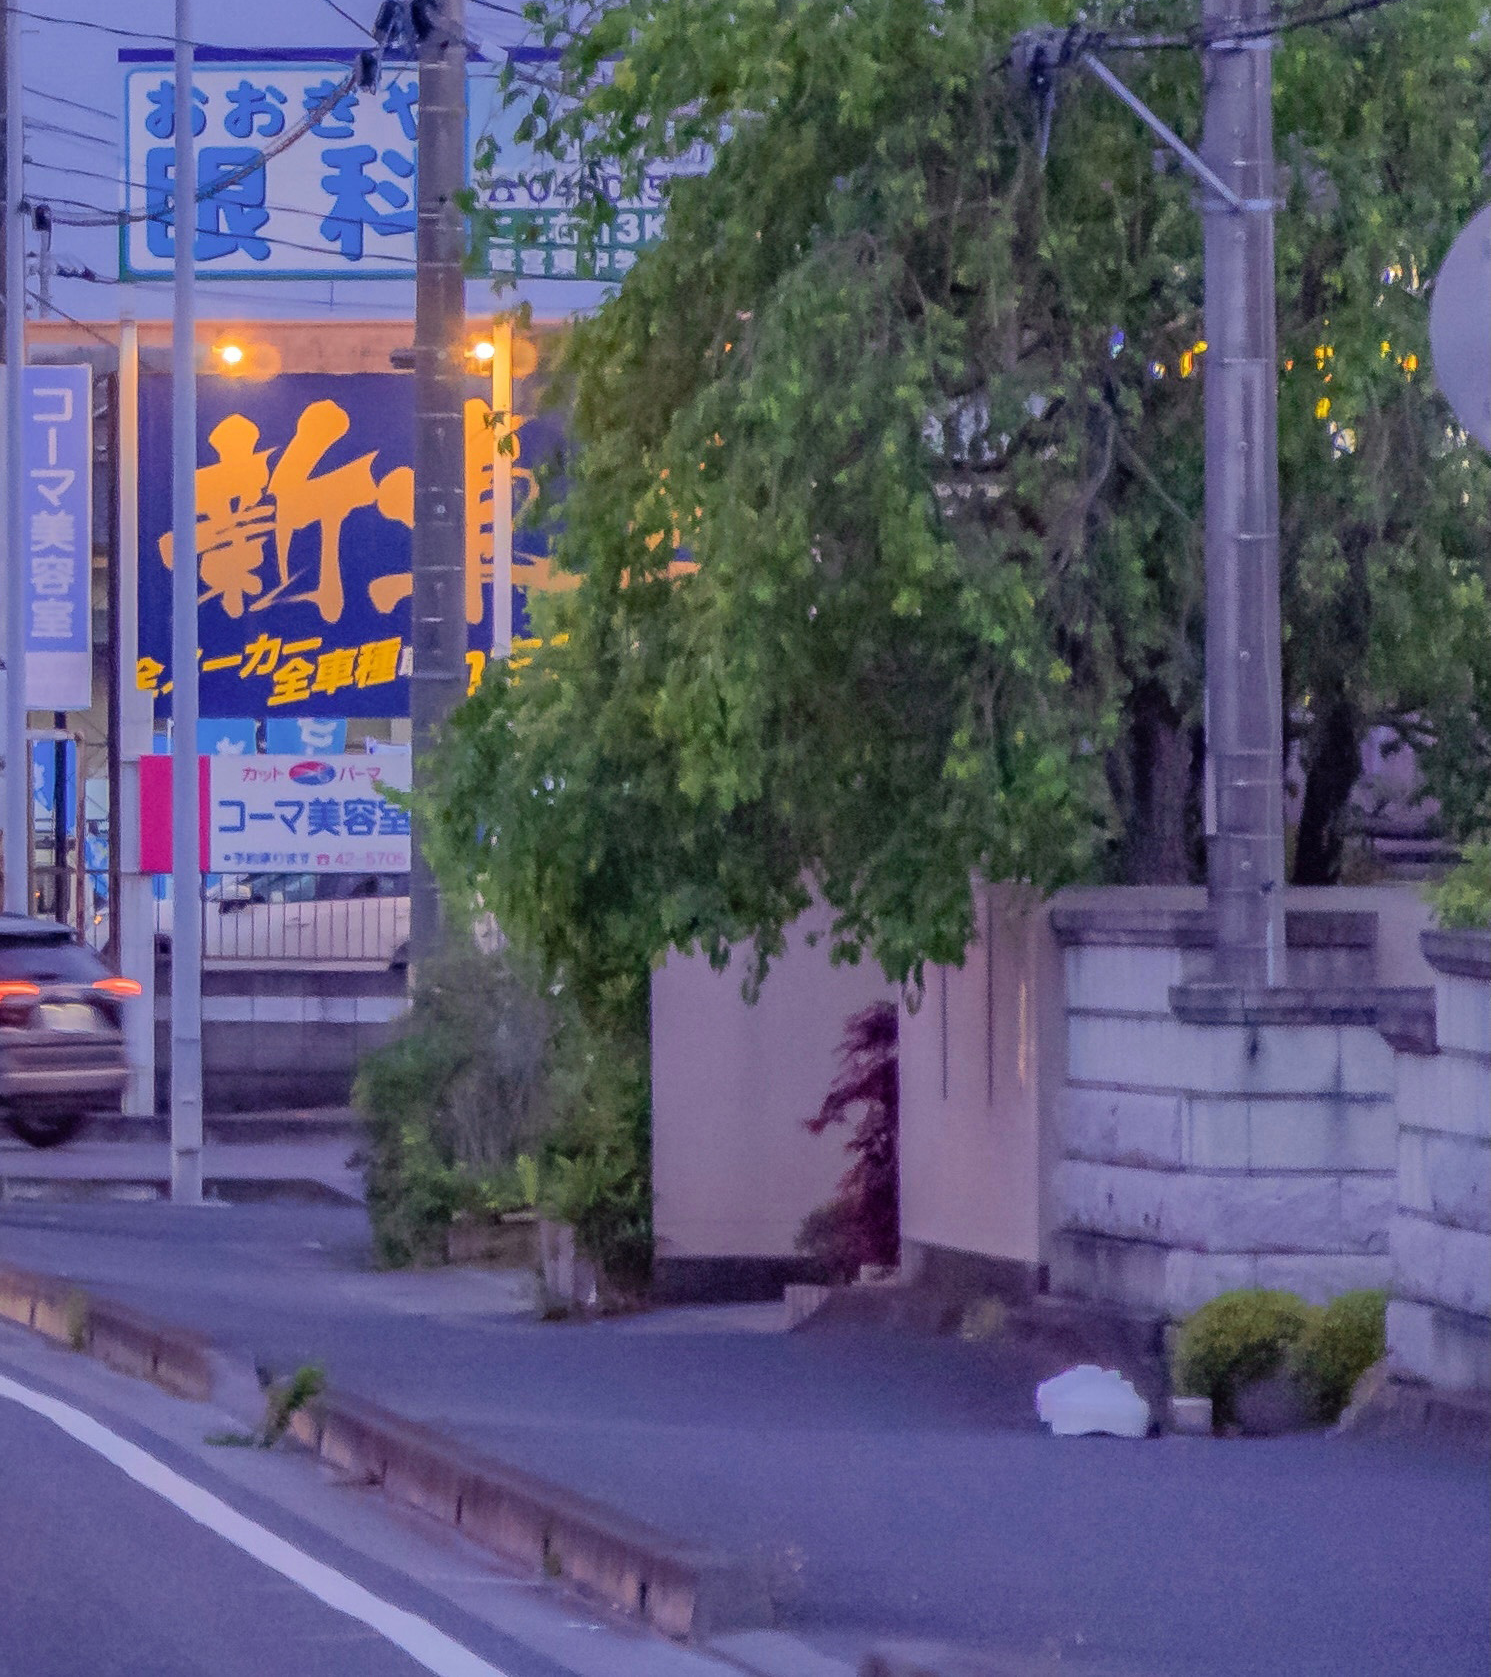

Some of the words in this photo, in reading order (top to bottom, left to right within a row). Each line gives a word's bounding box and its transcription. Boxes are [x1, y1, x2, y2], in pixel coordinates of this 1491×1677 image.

[30, 387, 75, 639] コーマ美容室
[243, 766, 289, 783] カット
[218, 798, 410, 837] コーマ美容室
